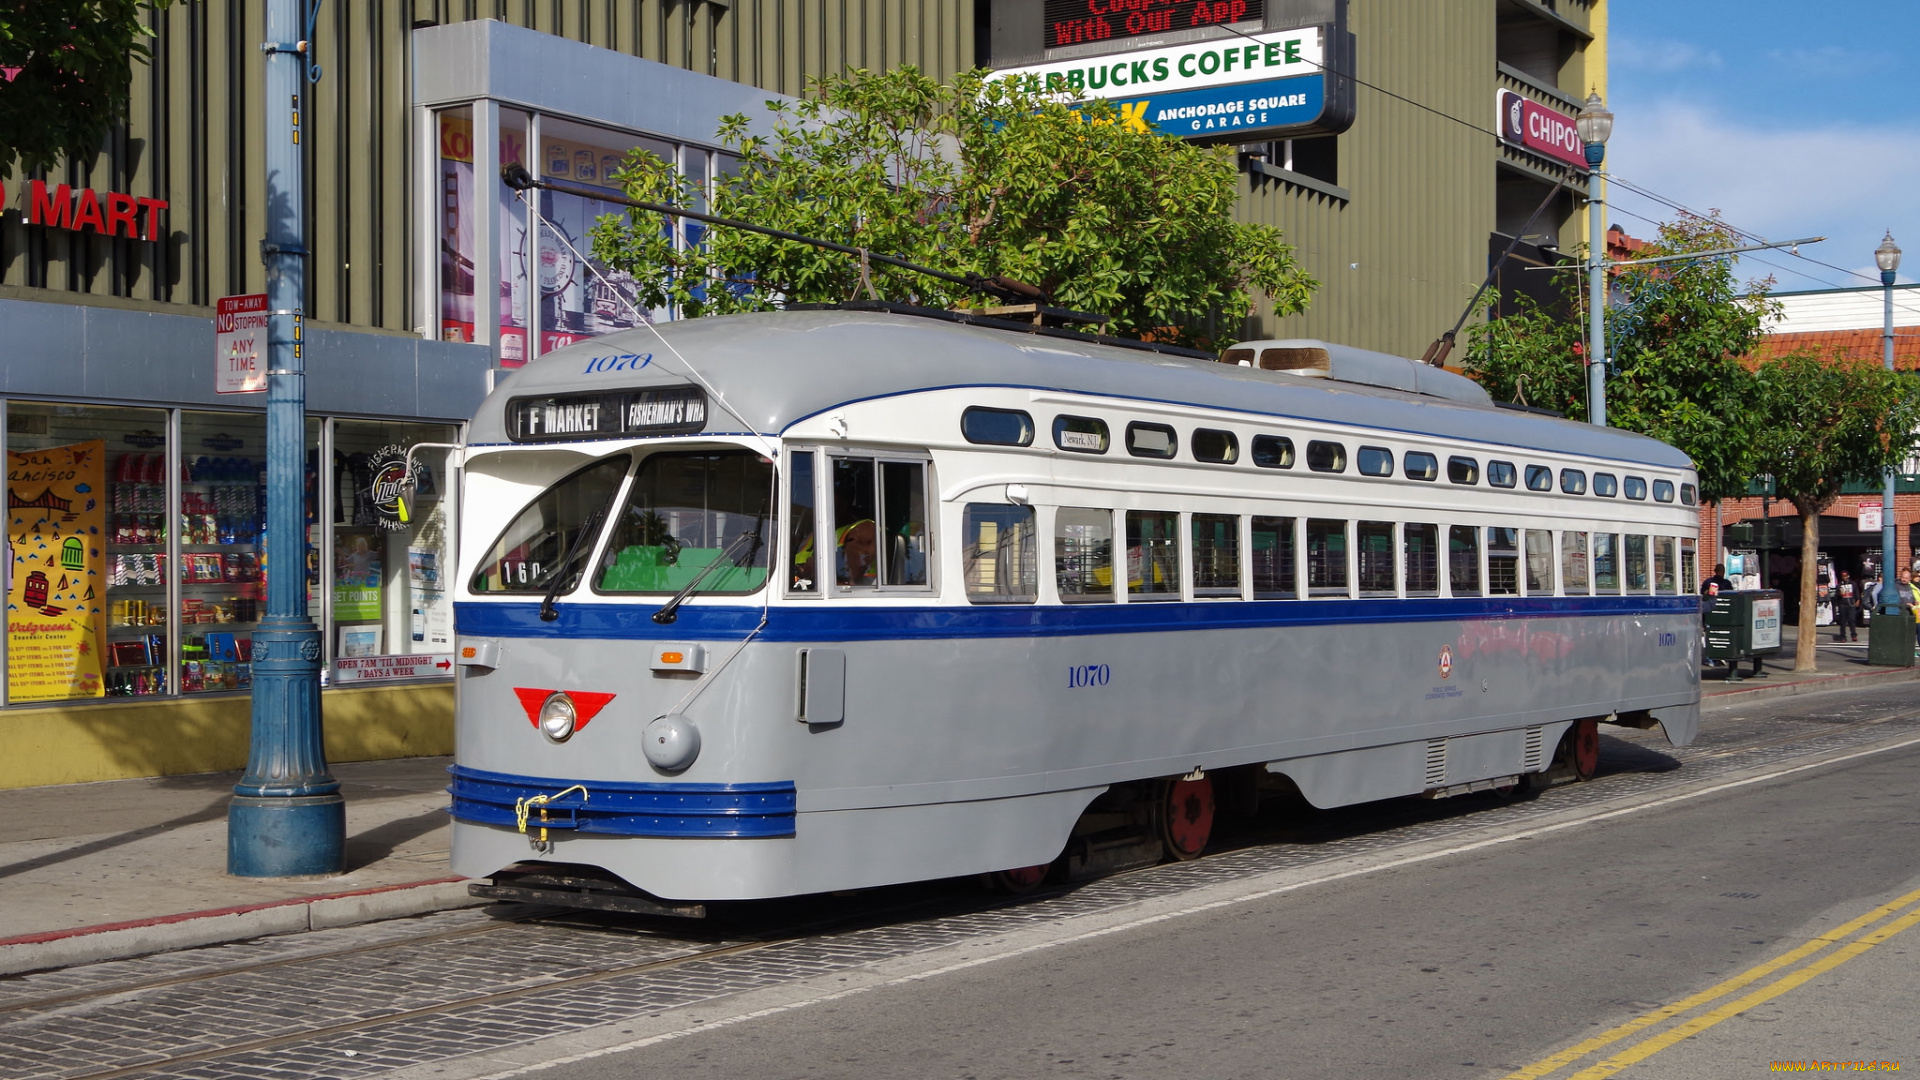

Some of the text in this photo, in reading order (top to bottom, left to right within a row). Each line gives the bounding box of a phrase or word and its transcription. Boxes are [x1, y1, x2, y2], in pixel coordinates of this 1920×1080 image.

[1054, 0, 1247, 45] With Our App
[991, 39, 1302, 94] RBUCKS COFFEE
[1157, 100, 1244, 121] ANCHORAGE
[1249, 93, 1306, 112] SQUARE
[1191, 112, 1268, 131] GARAGE
[1529, 112, 1585, 157] CHIPOT
[31, 179, 169, 242] MART
[225, 298, 262, 311] TOW-AWAY
[218, 313, 268, 332] NO STOPPING
[231, 339, 254, 354] ANY
[229, 357, 256, 371] TIME
[582, 353, 653, 374] 1070
[530, 398, 704, 435] F MARKET FISHERMAN'S WHA
[15, 452, 52, 466] San
[349, 590, 378, 601] POINTS
[8, 622, 74, 635] Walgreens
[1659, 633, 1676, 646] 1070
[337, 656, 433, 670] OPEN 7AM 'TIL MIDNIGHT
[357, 666, 415, 679] 7 DAYS A WEEK
[1067, 664, 1110, 688] 1070
